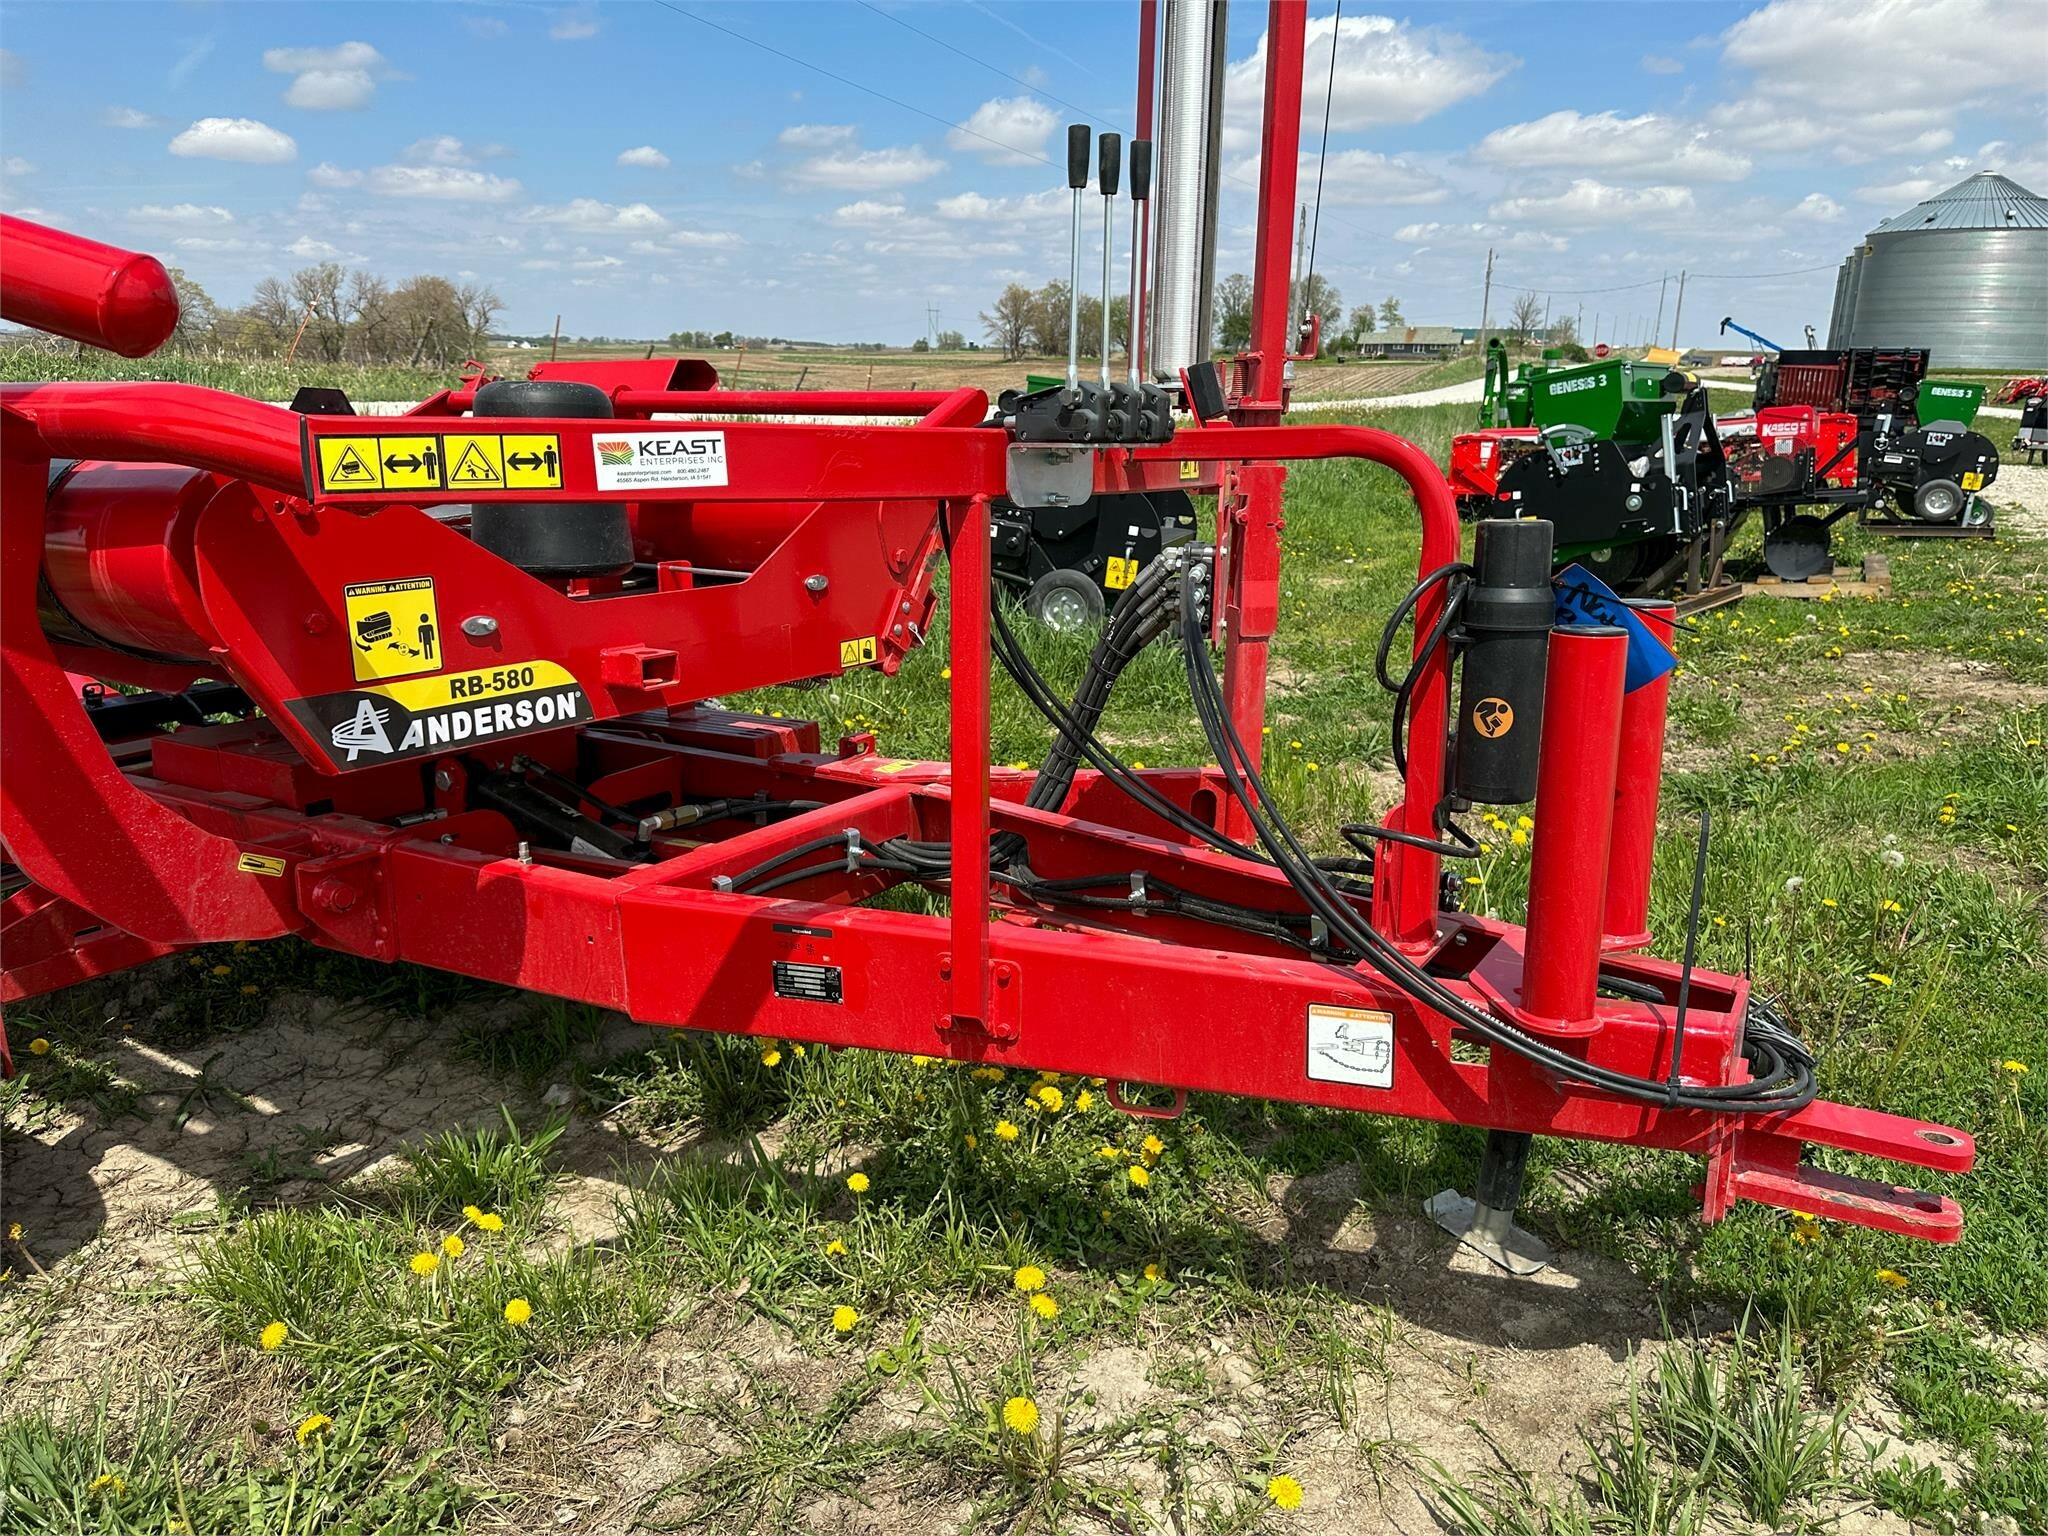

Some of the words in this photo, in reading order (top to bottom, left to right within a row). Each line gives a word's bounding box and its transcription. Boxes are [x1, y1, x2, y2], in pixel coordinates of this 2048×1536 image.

[1549, 376, 1596, 396] GENESIS
[1598, 374, 1608, 387] 3
[1931, 387, 1964, 397] GENESIS
[1965, 389, 1973, 398] 3
[1761, 422, 1799, 437] KASCO
[638, 438, 721, 456] KEAST
[640, 457, 705, 466] ENTERPRISES
[707, 455, 723, 463] INC
[355, 585, 386, 595] WARNING
[396, 581, 430, 590] ATTENTION
[450, 667, 534, 699] RB-580
[398, 691, 577, 751] ANDERSON
